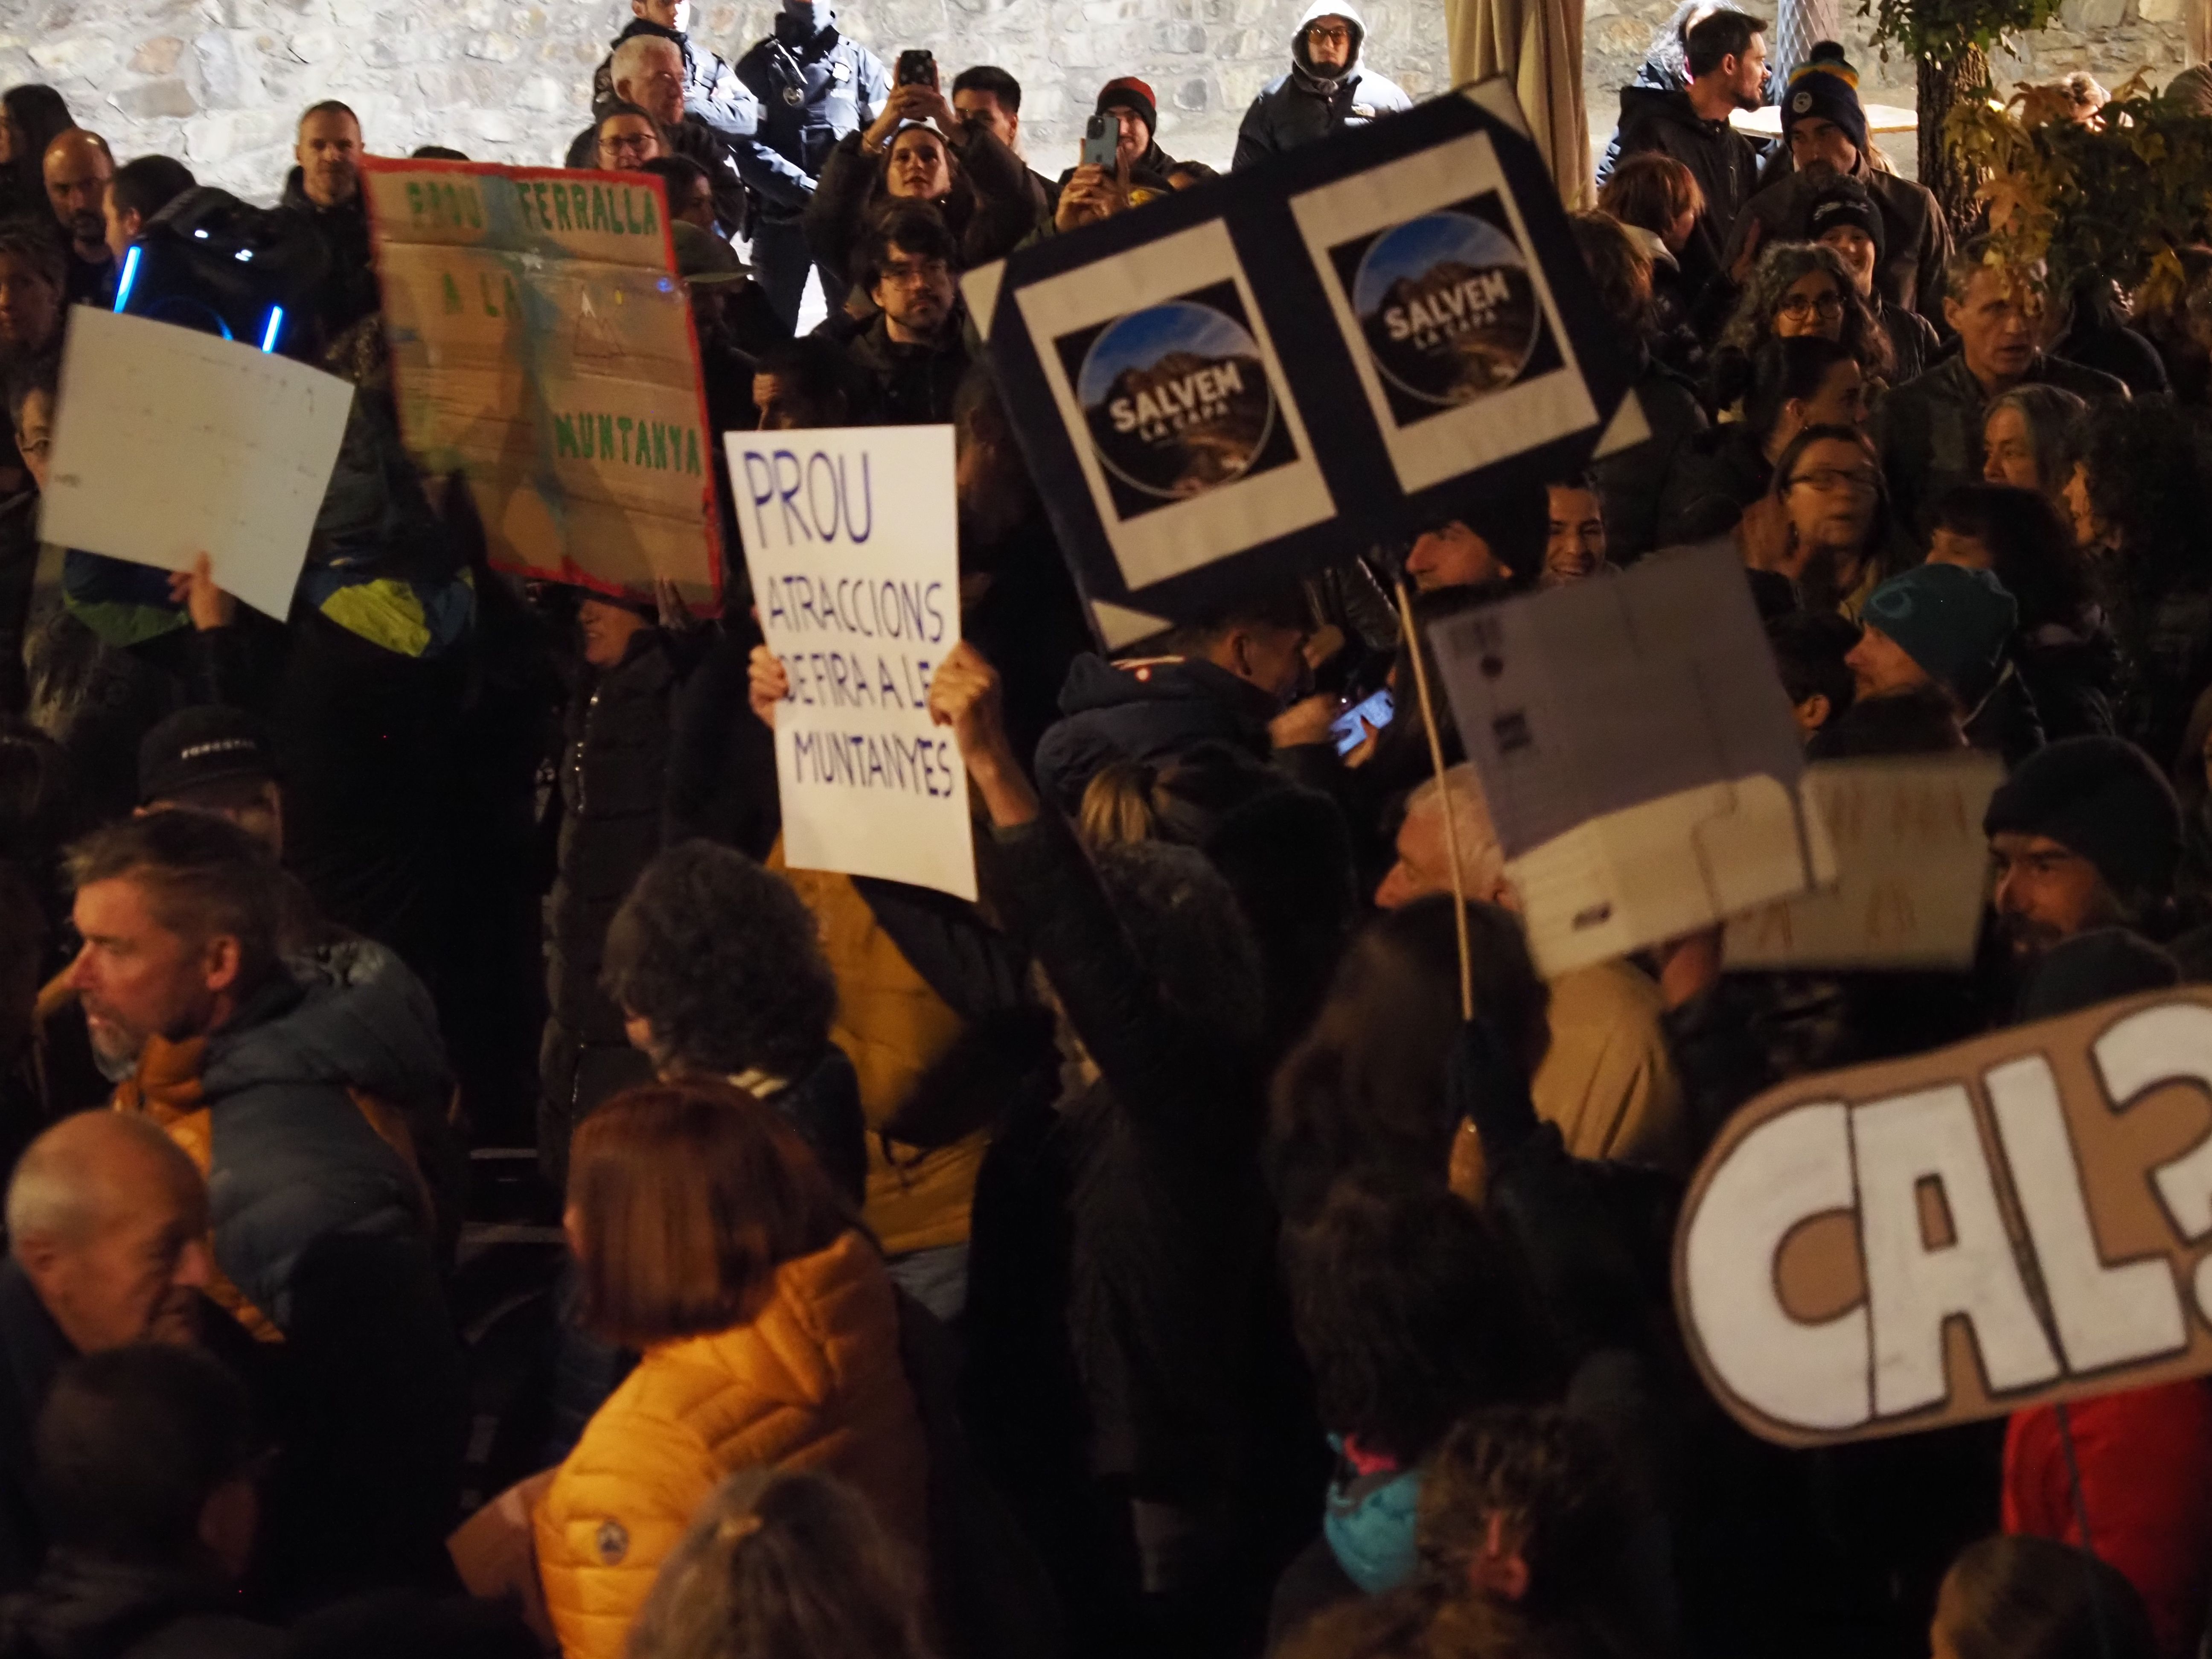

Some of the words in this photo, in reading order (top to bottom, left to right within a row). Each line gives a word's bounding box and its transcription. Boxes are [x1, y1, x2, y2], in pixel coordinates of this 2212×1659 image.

[515, 182, 658, 236] FERRALLA
[442, 272, 463, 317] A
[1383, 269, 1511, 341] SALVEM
[1109, 361, 1244, 434] SALVEM
[554, 411, 703, 478] MUNTANYA
[743, 449, 872, 550] PROU
[768, 575, 945, 643] ATRACCIONS
[900, 653, 931, 708] LE
[793, 731, 955, 800] MUNTANYES
